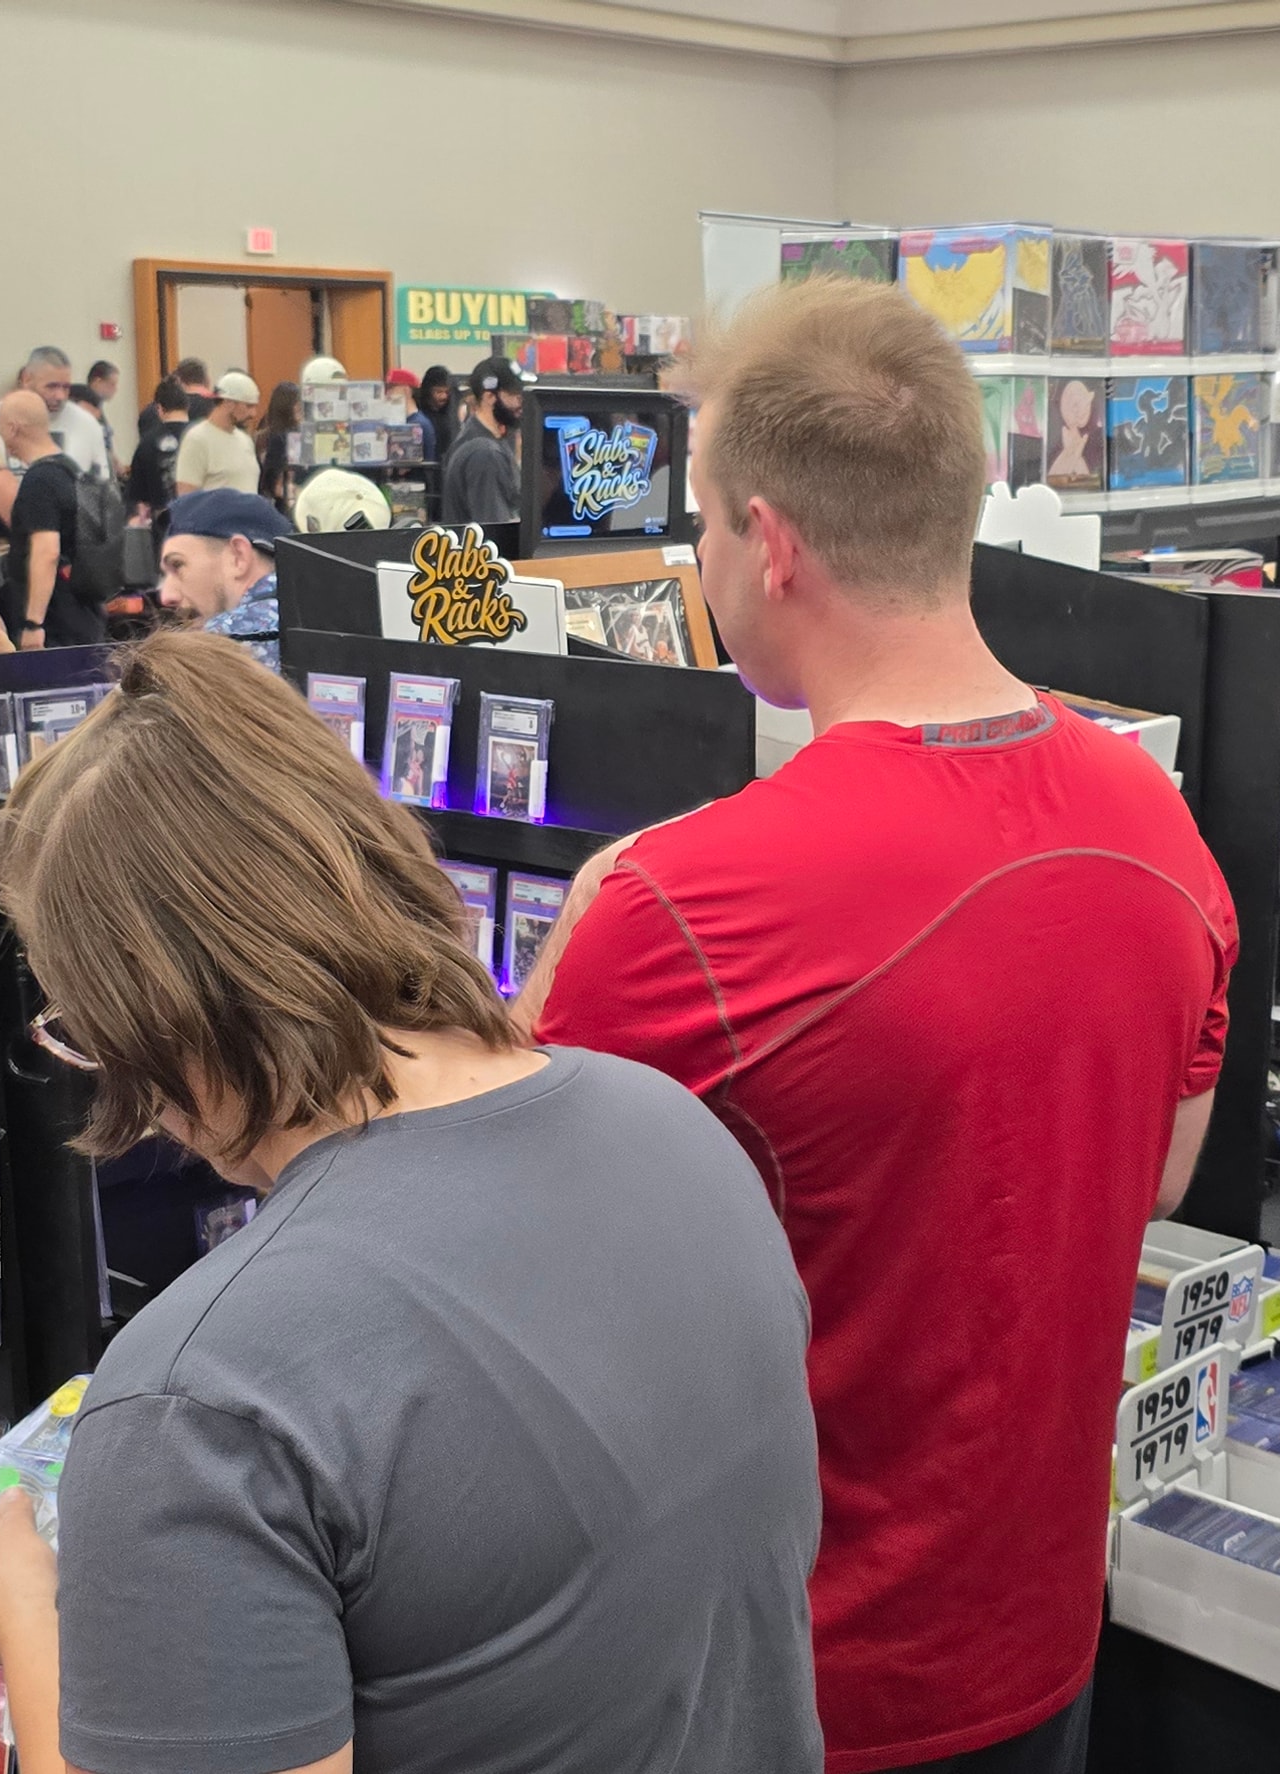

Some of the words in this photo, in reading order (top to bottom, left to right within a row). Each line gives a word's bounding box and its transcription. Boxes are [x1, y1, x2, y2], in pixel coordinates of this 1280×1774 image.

[408, 290, 547, 327] BUYIN
[572, 425, 640, 479] Slabs
[574, 461, 648, 514] Racks
[408, 527, 506, 595] Slabs
[413, 579, 526, 645] Racks
[1181, 1271, 1229, 1315] 1950
[1174, 1315, 1224, 1360] 1979
[1137, 1376, 1191, 1433] 1950
[1135, 1422, 1189, 1481] 1979
